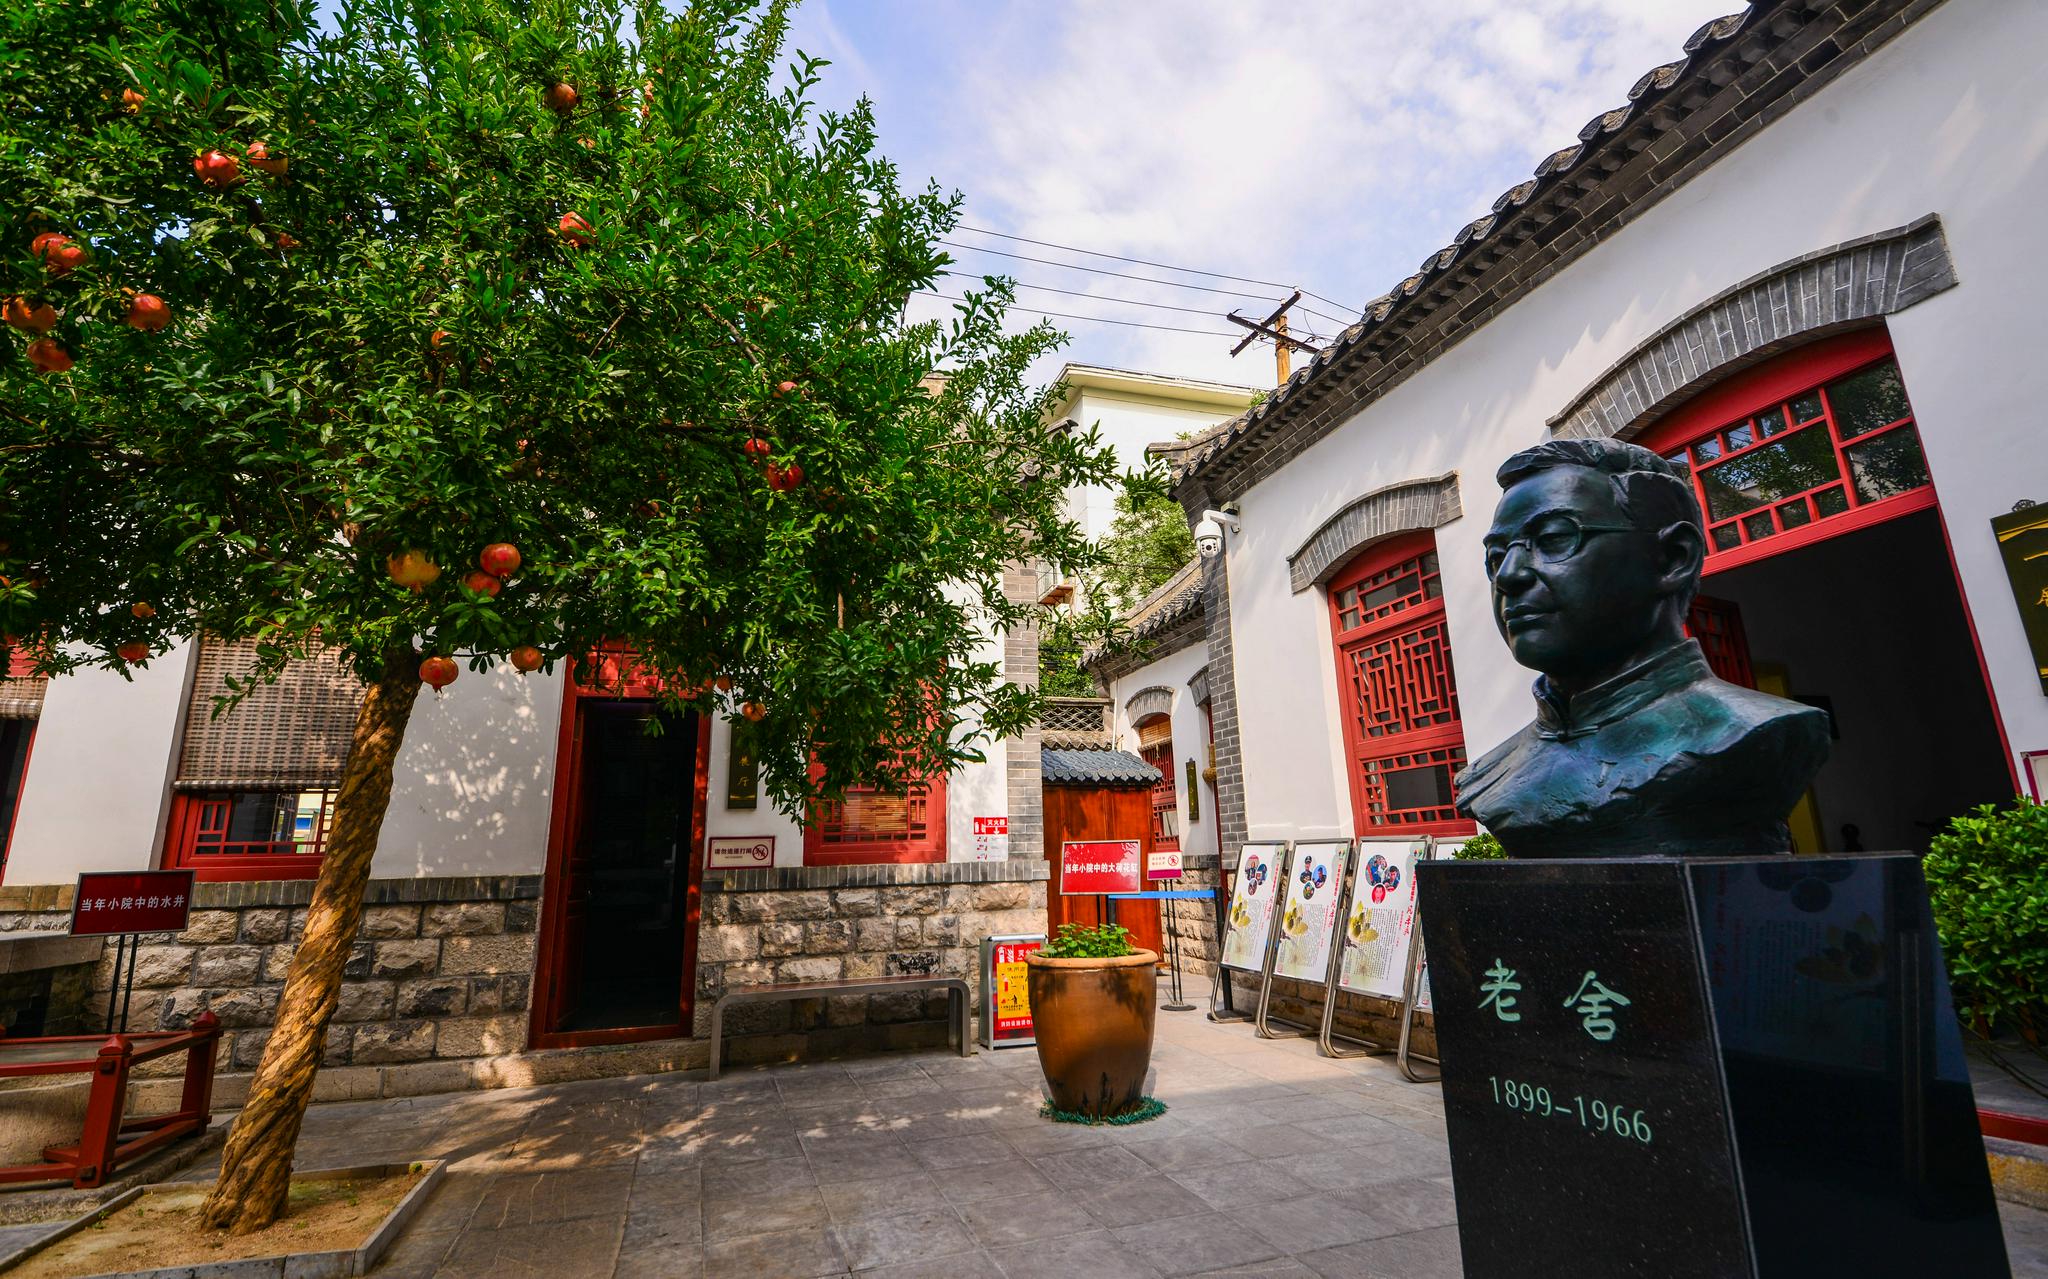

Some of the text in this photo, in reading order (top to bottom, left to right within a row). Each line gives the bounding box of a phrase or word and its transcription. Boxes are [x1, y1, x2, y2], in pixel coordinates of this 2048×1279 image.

[81, 894, 185, 911] 当年小院中的水井
[1478, 957, 1632, 1040] 老舍
